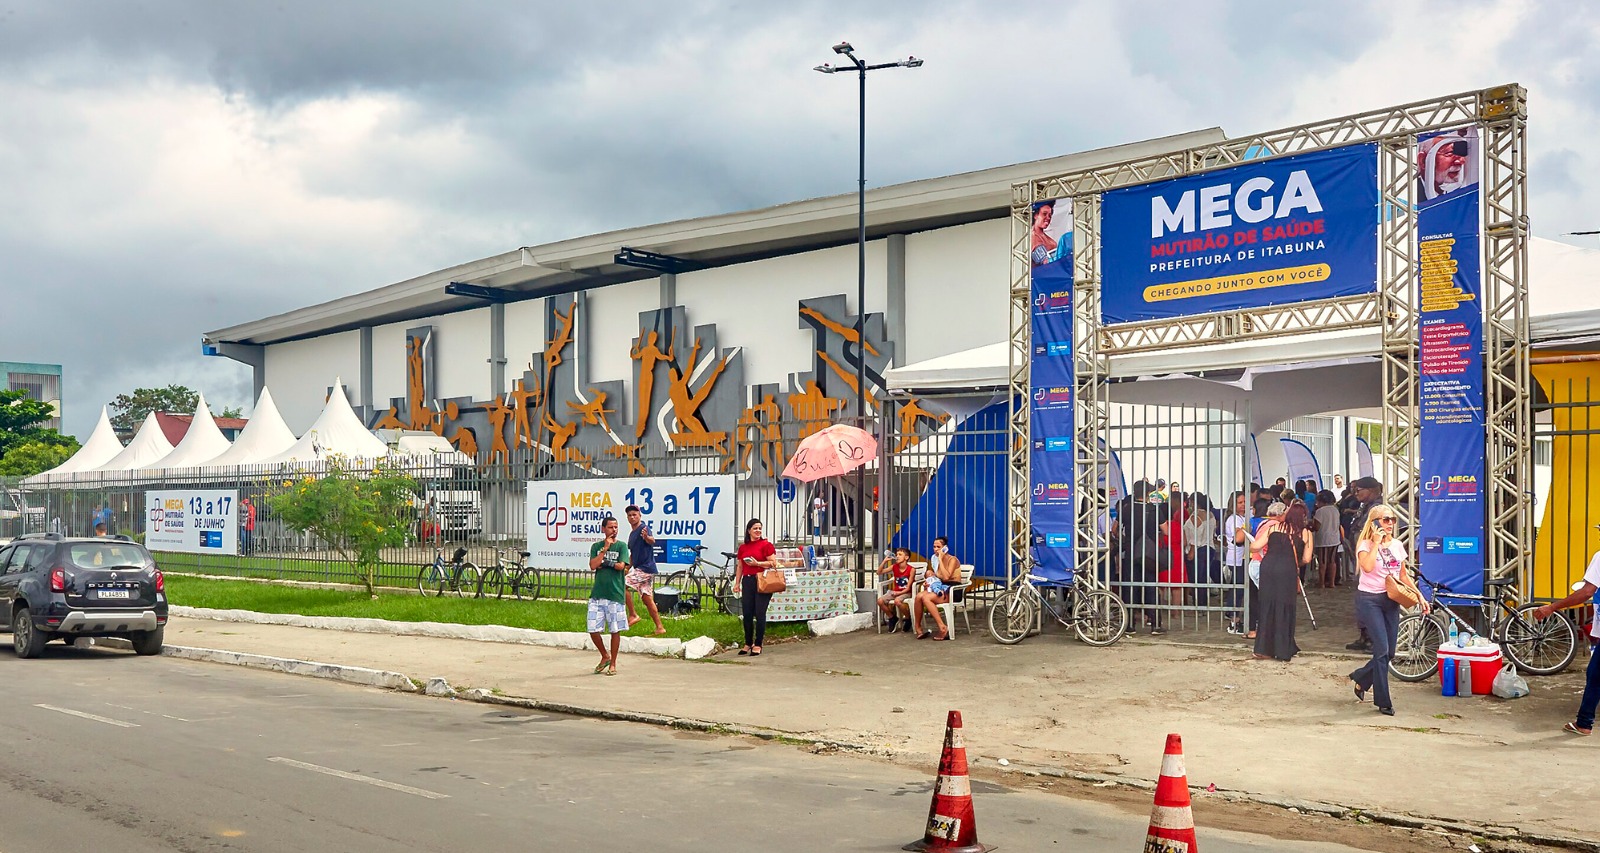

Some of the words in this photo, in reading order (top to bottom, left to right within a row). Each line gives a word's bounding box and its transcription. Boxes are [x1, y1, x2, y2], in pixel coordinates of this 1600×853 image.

[1152, 170, 1323, 238] MEGA
[1151, 233, 1228, 258] MUTIRÃO
[1233, 230, 1257, 246] DE
[1262, 219, 1325, 242] SAÚDE
[1150, 254, 1232, 273] PREFEITURA
[1238, 249, 1255, 260] DE
[1261, 240, 1326, 257] ITABUNA
[1150, 283, 1212, 298] CHEGANDO
[1216, 278, 1254, 290] JUNTO
[1259, 274, 1285, 284] COM
[1290, 266, 1323, 281] VOCÊ
[165, 499, 184, 510] MEGA
[189, 496, 202, 514] 13
[206, 502, 212, 515] a
[218, 497, 232, 515] 17
[570, 492, 612, 508] MEGA
[625, 488, 654, 514] 13
[663, 494, 678, 514] a
[688, 486, 720, 514] 17
[571, 508, 612, 520] MUTIRÃO
[194, 518, 202, 528] DE
[203, 518, 225, 528] JUNHO
[571, 524, 582, 534] DE
[584, 522, 605, 534] SAÚ
[656, 520, 706, 536] JUNHO
